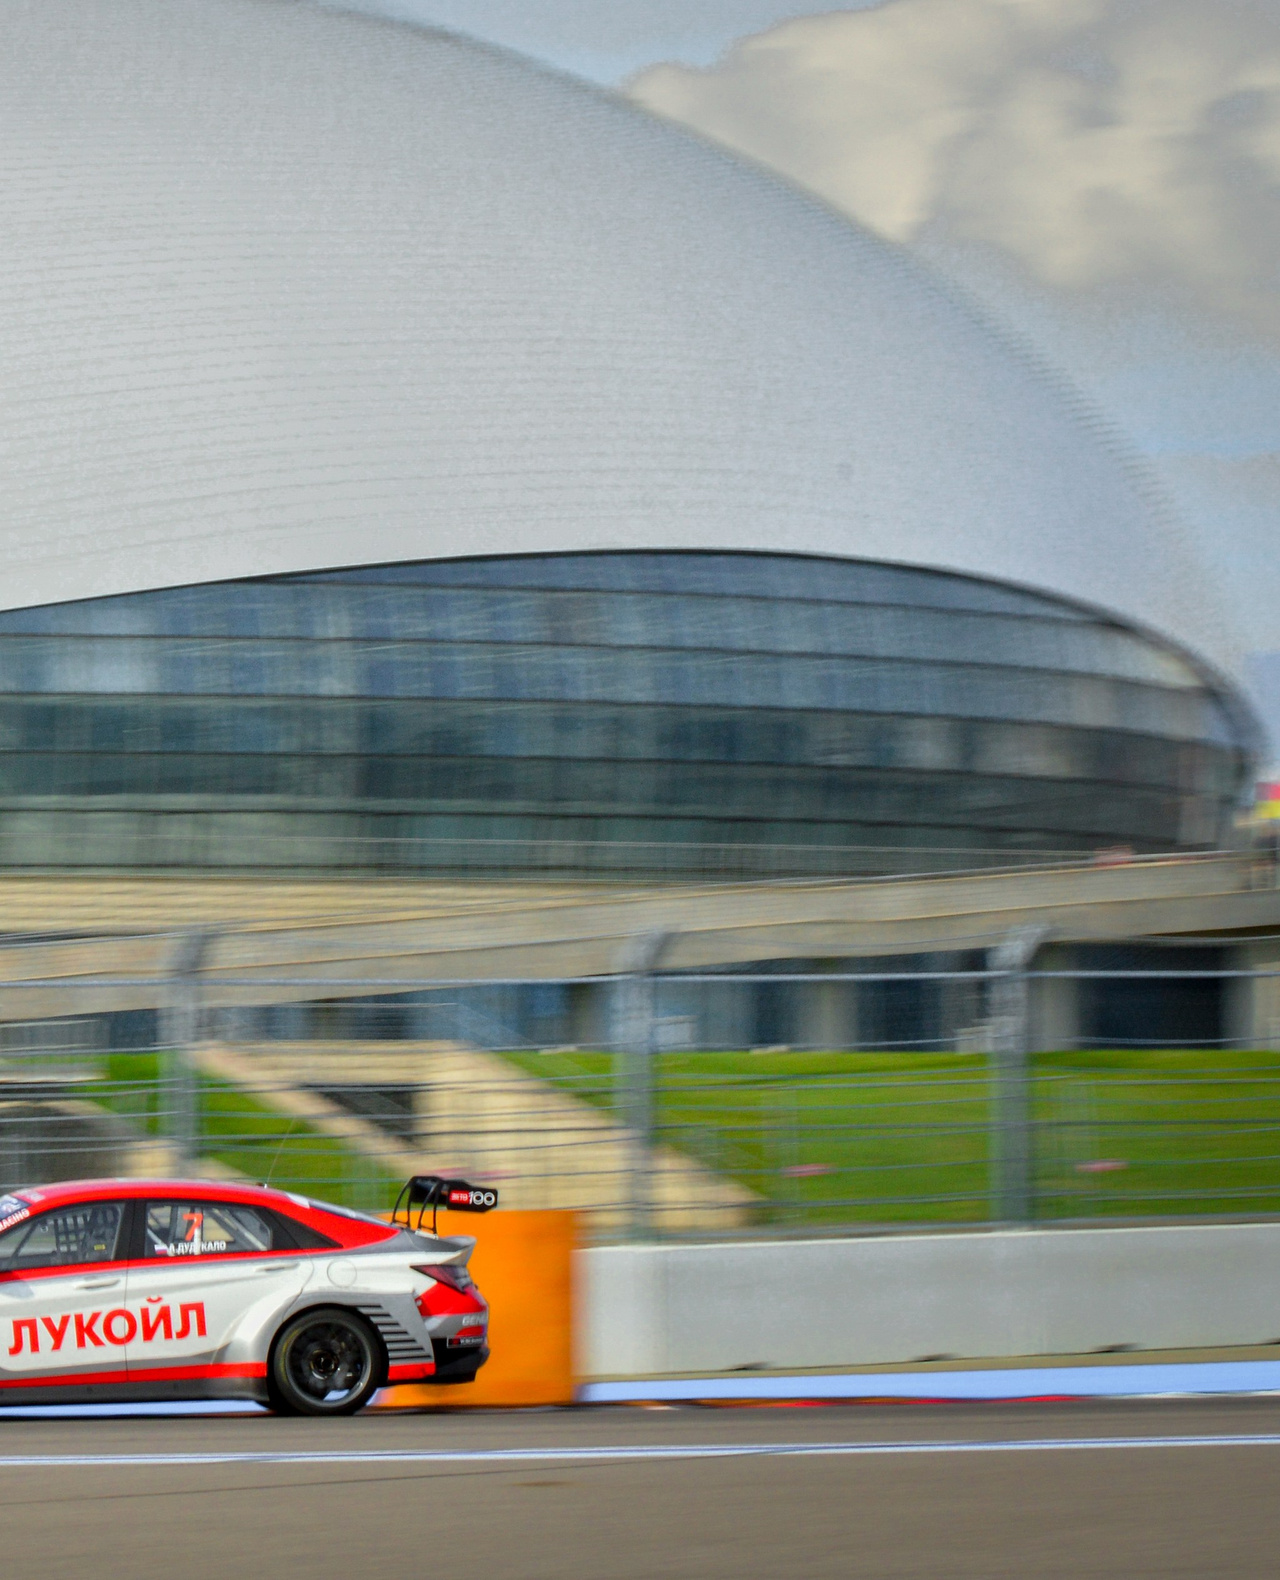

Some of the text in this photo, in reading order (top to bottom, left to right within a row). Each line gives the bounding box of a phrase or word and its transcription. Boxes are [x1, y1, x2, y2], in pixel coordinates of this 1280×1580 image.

[468, 1190, 496, 1206] 100
[182, 1212, 203, 1241] 7
[8, 1295, 208, 1357] ЛУКОЙЛ
